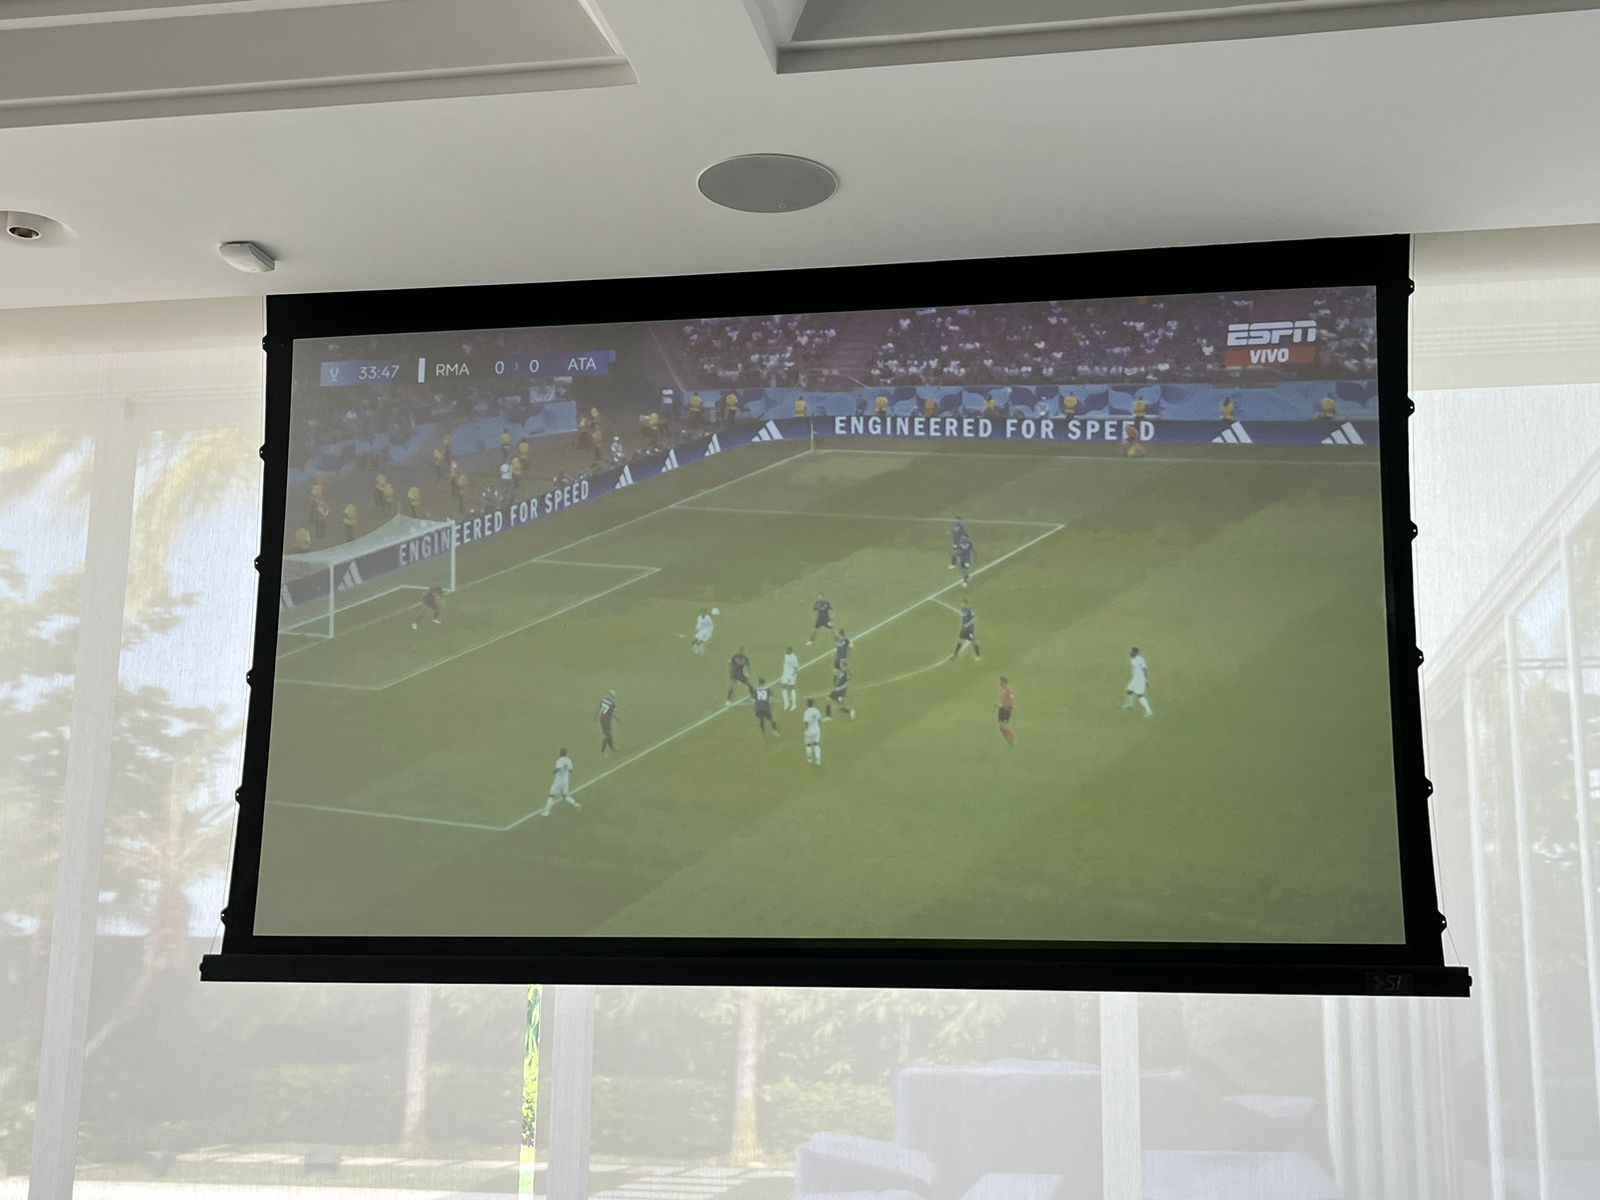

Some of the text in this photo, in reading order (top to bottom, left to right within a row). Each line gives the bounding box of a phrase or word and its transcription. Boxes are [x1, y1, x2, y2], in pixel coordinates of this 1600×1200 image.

[1227, 320, 1317, 346] ESPN
[1249, 347, 1290, 364] VIVO
[358, 357, 597, 380] 33:47 RMA 0 0 ATA
[834, 415, 993, 438] ENGINEERED
[1005, 418, 1055, 439] FOR
[509, 498, 538, 527] FOR
[544, 479, 589, 514] SPEED
